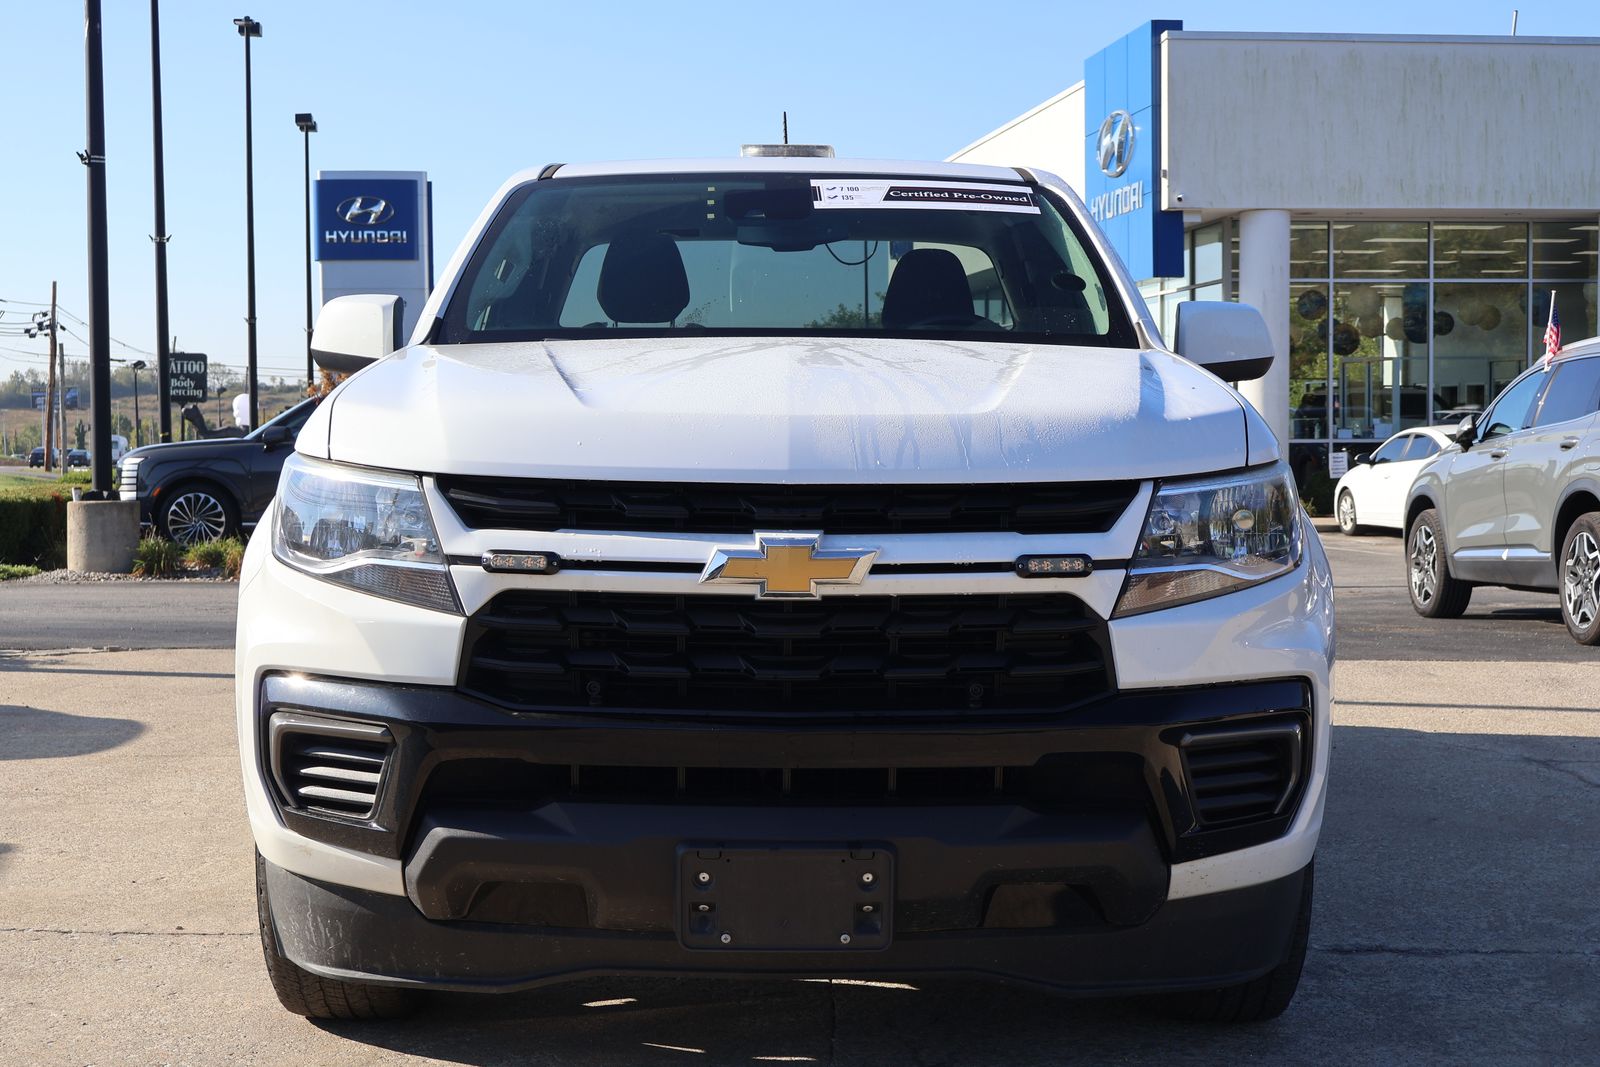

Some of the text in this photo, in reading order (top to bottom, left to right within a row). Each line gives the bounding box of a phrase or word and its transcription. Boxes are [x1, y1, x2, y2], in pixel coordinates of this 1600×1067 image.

[890, 190, 1028, 203] Certified Pre-Owned
[1091, 180, 1143, 222] HYUNDAI
[325, 230, 407, 243] HYUNDAI
[171, 378, 195, 389] Body
[170, 386, 203, 398] iercing
